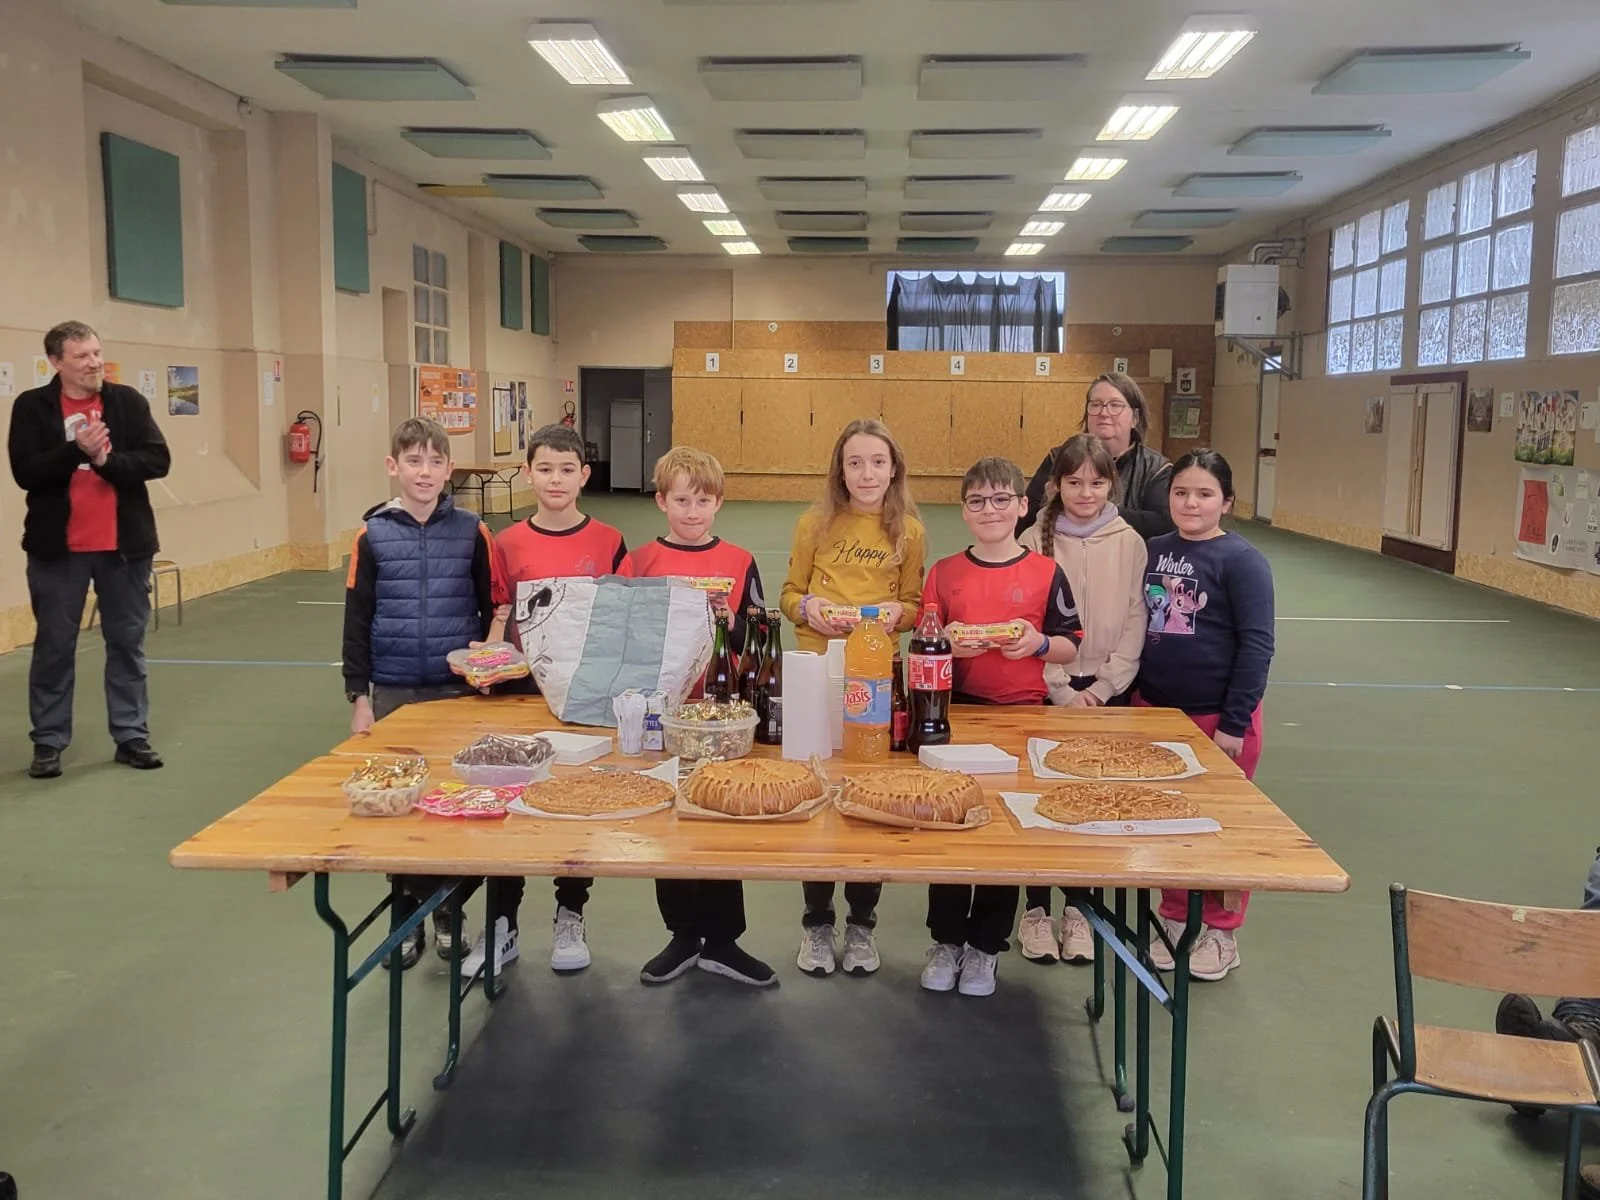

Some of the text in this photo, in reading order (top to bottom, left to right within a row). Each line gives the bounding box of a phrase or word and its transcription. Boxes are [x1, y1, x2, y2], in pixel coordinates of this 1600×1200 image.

[708, 355, 715, 368] 1
[787, 358, 795, 369] 2
[873, 359, 881, 369] 3
[953, 360, 961, 371] 4
[1039, 361, 1047, 372] 5
[1117, 362, 1125, 373] 6
[832, 539, 889, 568] Happy
[1156, 552, 1194, 575] Winter
